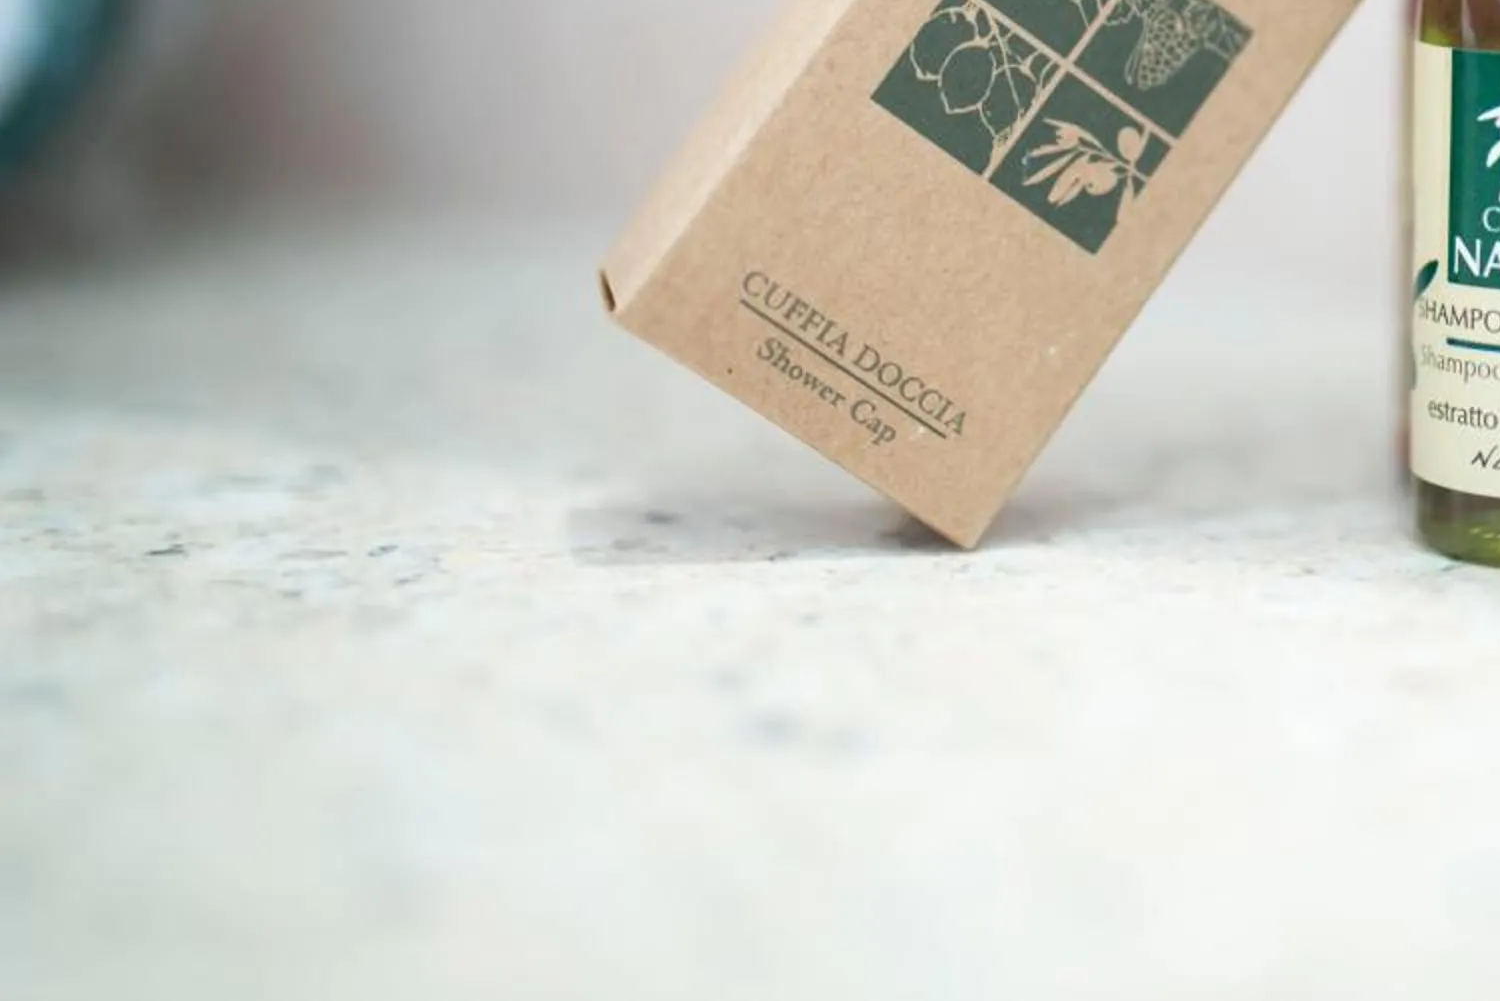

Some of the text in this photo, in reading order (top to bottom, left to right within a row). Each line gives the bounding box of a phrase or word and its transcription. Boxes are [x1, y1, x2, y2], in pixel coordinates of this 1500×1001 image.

[742, 270, 967, 436] CUFFIA DOCCIA
[756, 336, 897, 446] Shower Cap
[1427, 399, 1499, 431] estratto
